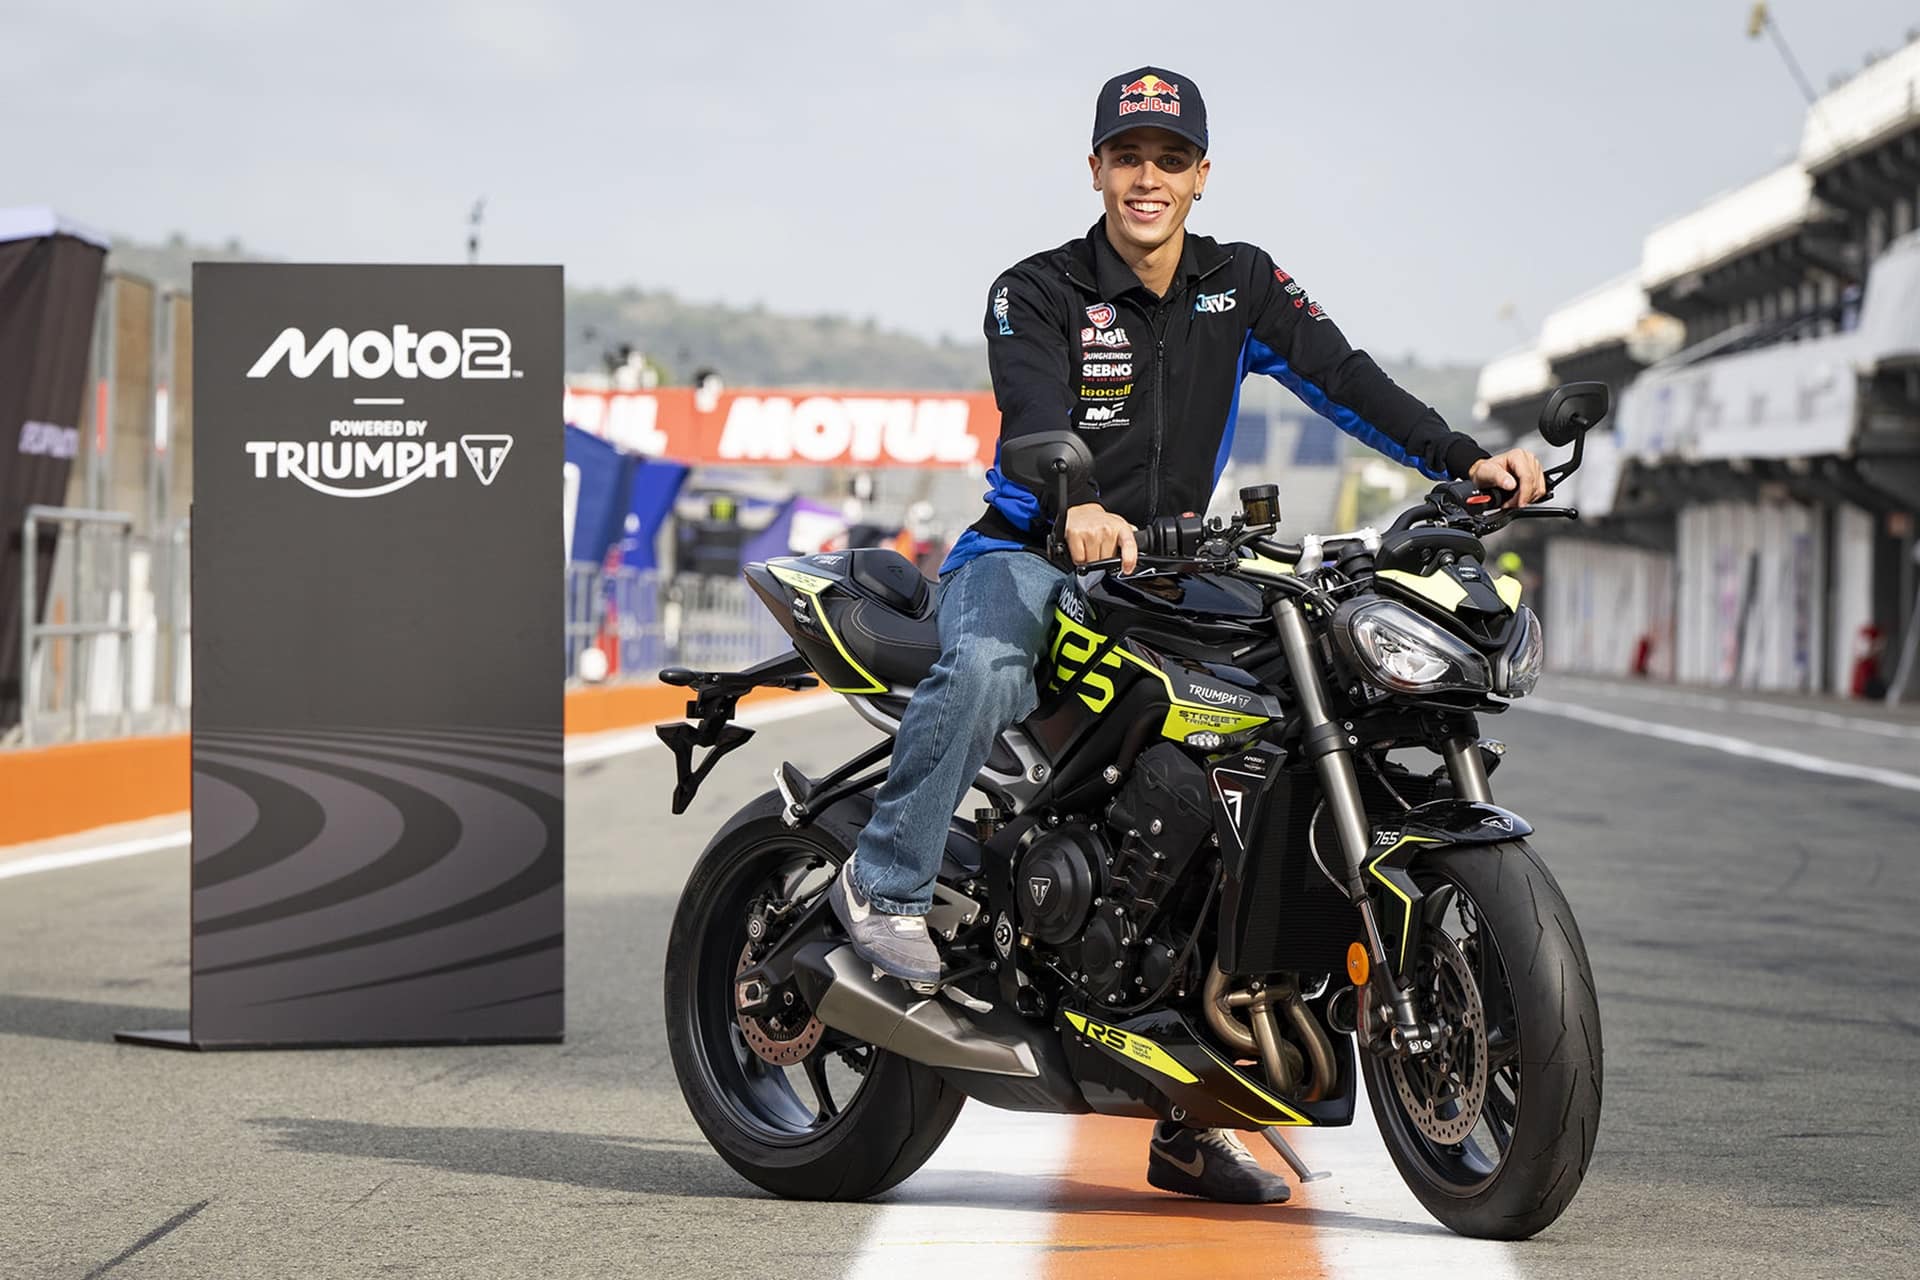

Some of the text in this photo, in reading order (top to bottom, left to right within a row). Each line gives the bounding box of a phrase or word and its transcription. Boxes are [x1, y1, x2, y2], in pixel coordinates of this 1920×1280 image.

[1119, 97, 1180, 116] Red Bull
[1080, 384, 1132, 397] isocell
[330, 420, 428, 437] POWERED BY
[717, 396, 981, 462] MOTUL
[245, 441, 457, 498] TRIUMPH
[1189, 684, 1238, 704] TRIUMPH
[1179, 710, 1241, 725] STREET
[1375, 831, 1400, 846] 765
[1083, 1019, 1127, 1051] RS
